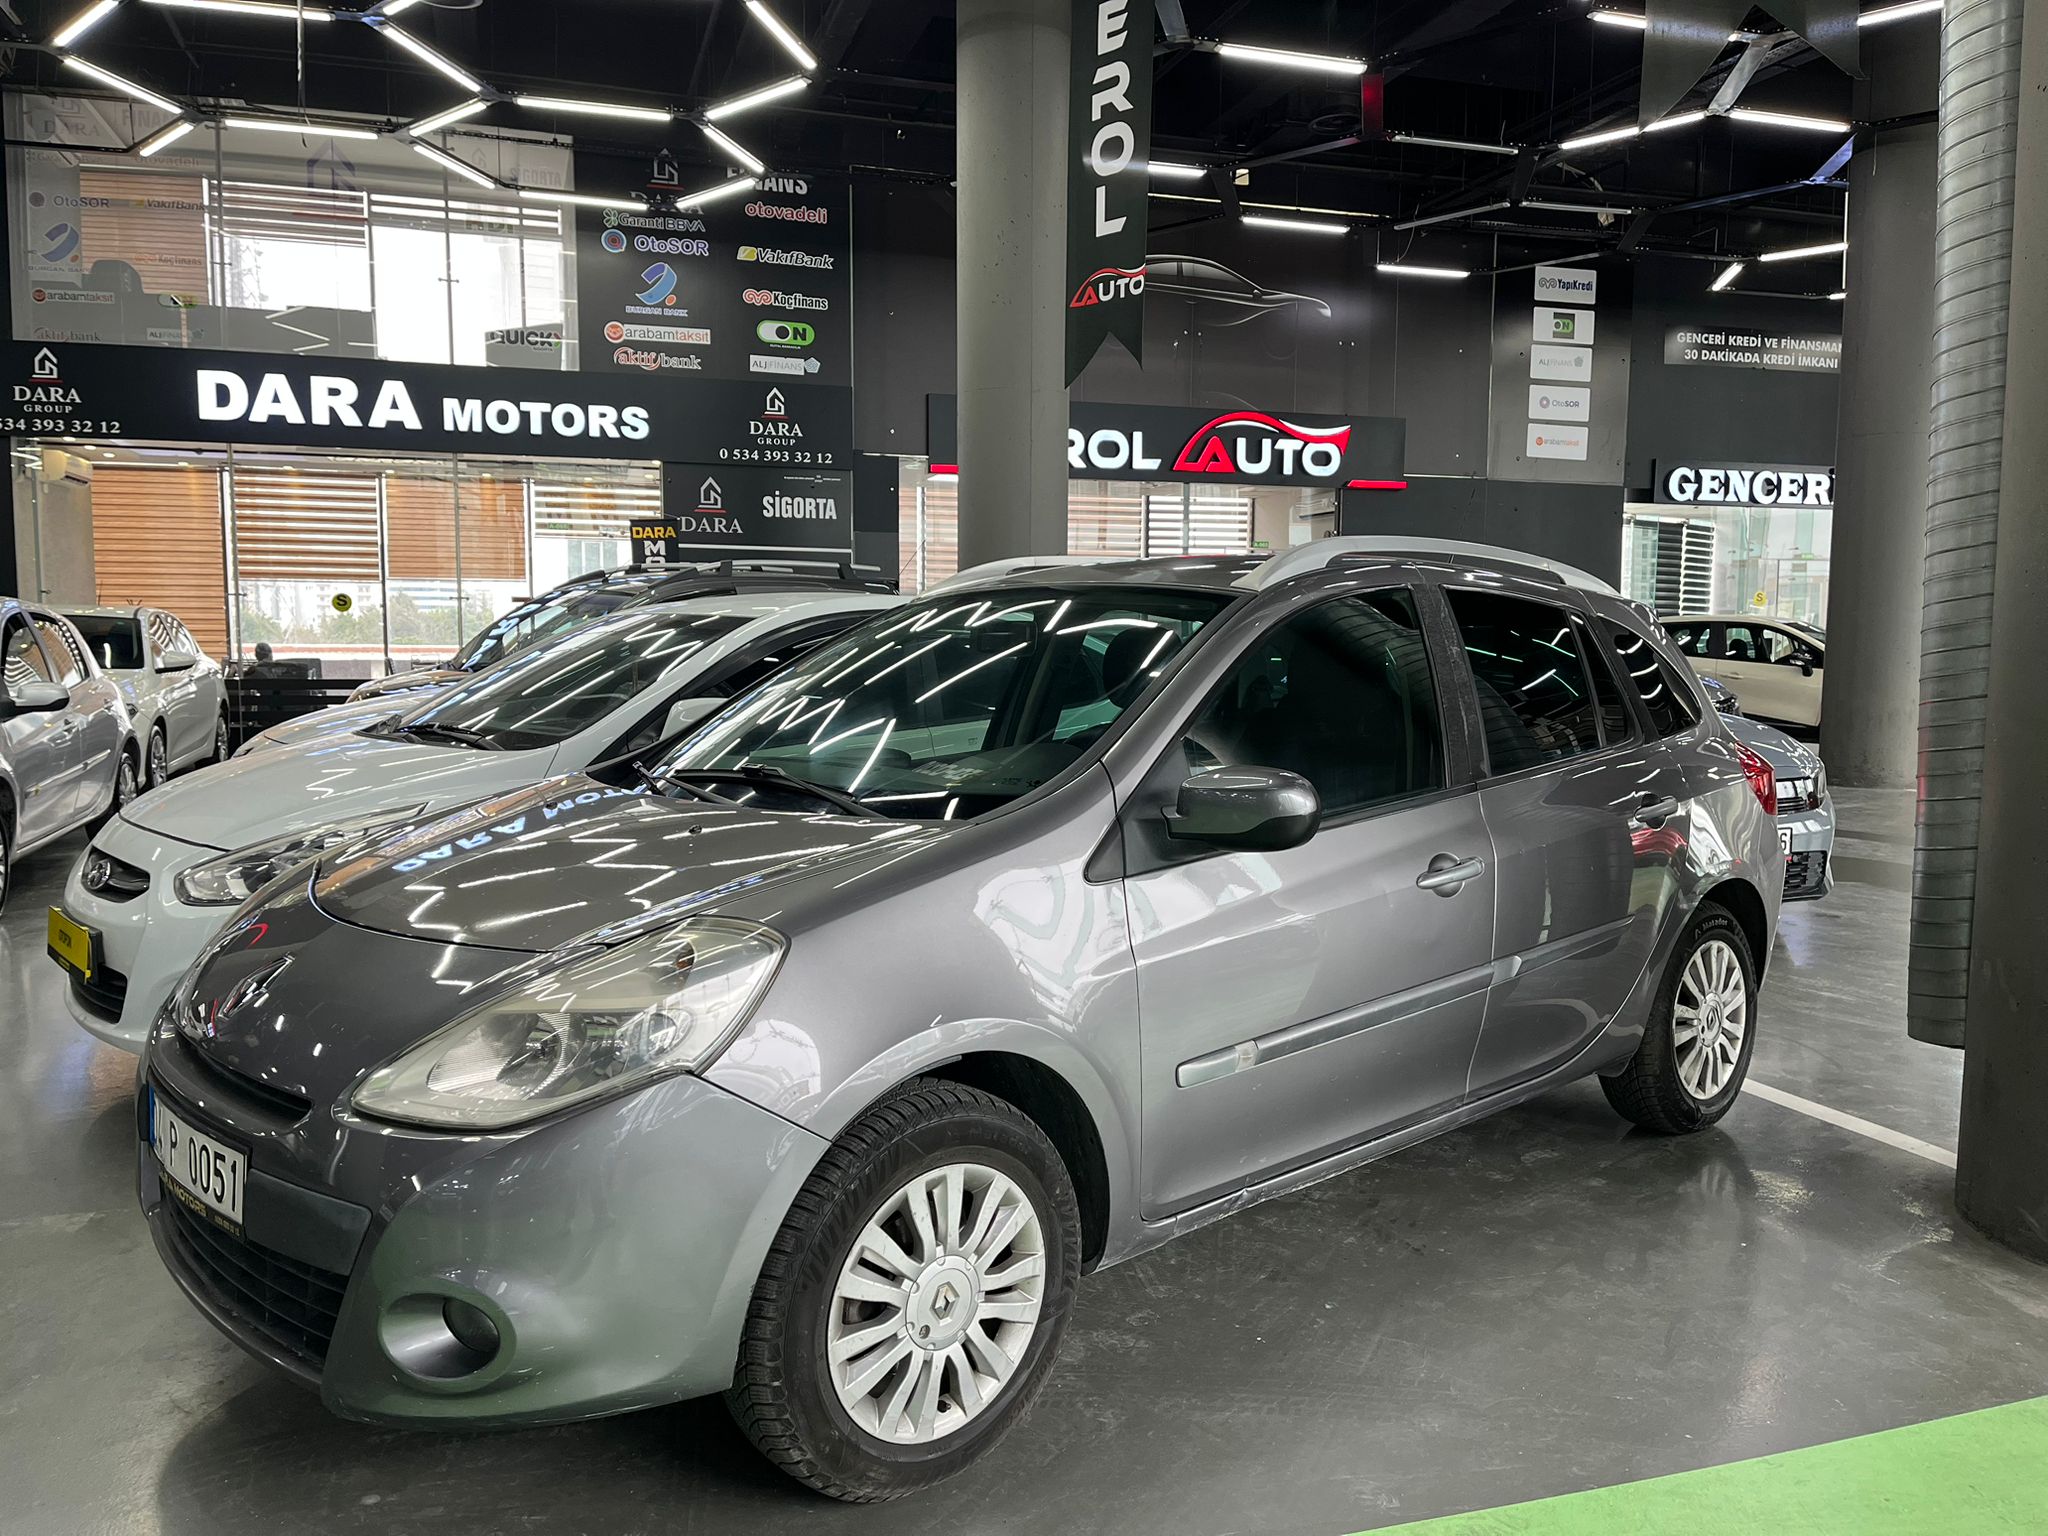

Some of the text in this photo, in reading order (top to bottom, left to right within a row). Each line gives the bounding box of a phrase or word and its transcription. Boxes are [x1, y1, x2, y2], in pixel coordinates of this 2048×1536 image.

[1091, 0, 1134, 237] EROL
[618, 212, 707, 233] Garanti BBVA
[745, 200, 828, 225] otovadeli
[634, 234, 710, 257] OtoSOR
[772, 291, 829, 310] Koçfinans
[1070, 273, 1146, 308] AUTO
[624, 327, 709, 343] arabamtaksit
[1676, 331, 1726, 346] GENCERİ
[1728, 333, 1762, 348] KREDİ
[1764, 337, 1778, 349] VE
[616, 348, 702, 370] aktif bank
[1684, 349, 1699, 360] 30
[1701, 348, 1760, 364] DAKİKADA
[1763, 352, 1796, 366] KREDİ
[13, 384, 82, 404] DARA
[23, 403, 73, 414] GROUP
[197, 368, 650, 441] DARA MOTORS
[0, 417, 121, 434] 34 393 32 12
[749, 420, 803, 438] DARA
[757, 437, 796, 446] GROUP
[719, 447, 833, 464] 0 534 393 32 12
[1172, 435, 1342, 478] AUTO
[1668, 466, 1836, 507] GENCER
[762, 490, 837, 520] SİGORTA
[632, 526, 677, 539] DARA
[680, 516, 744, 534] DARA
[169, 1119, 179, 1167] P
[188, 1136, 238, 1213] 0051
